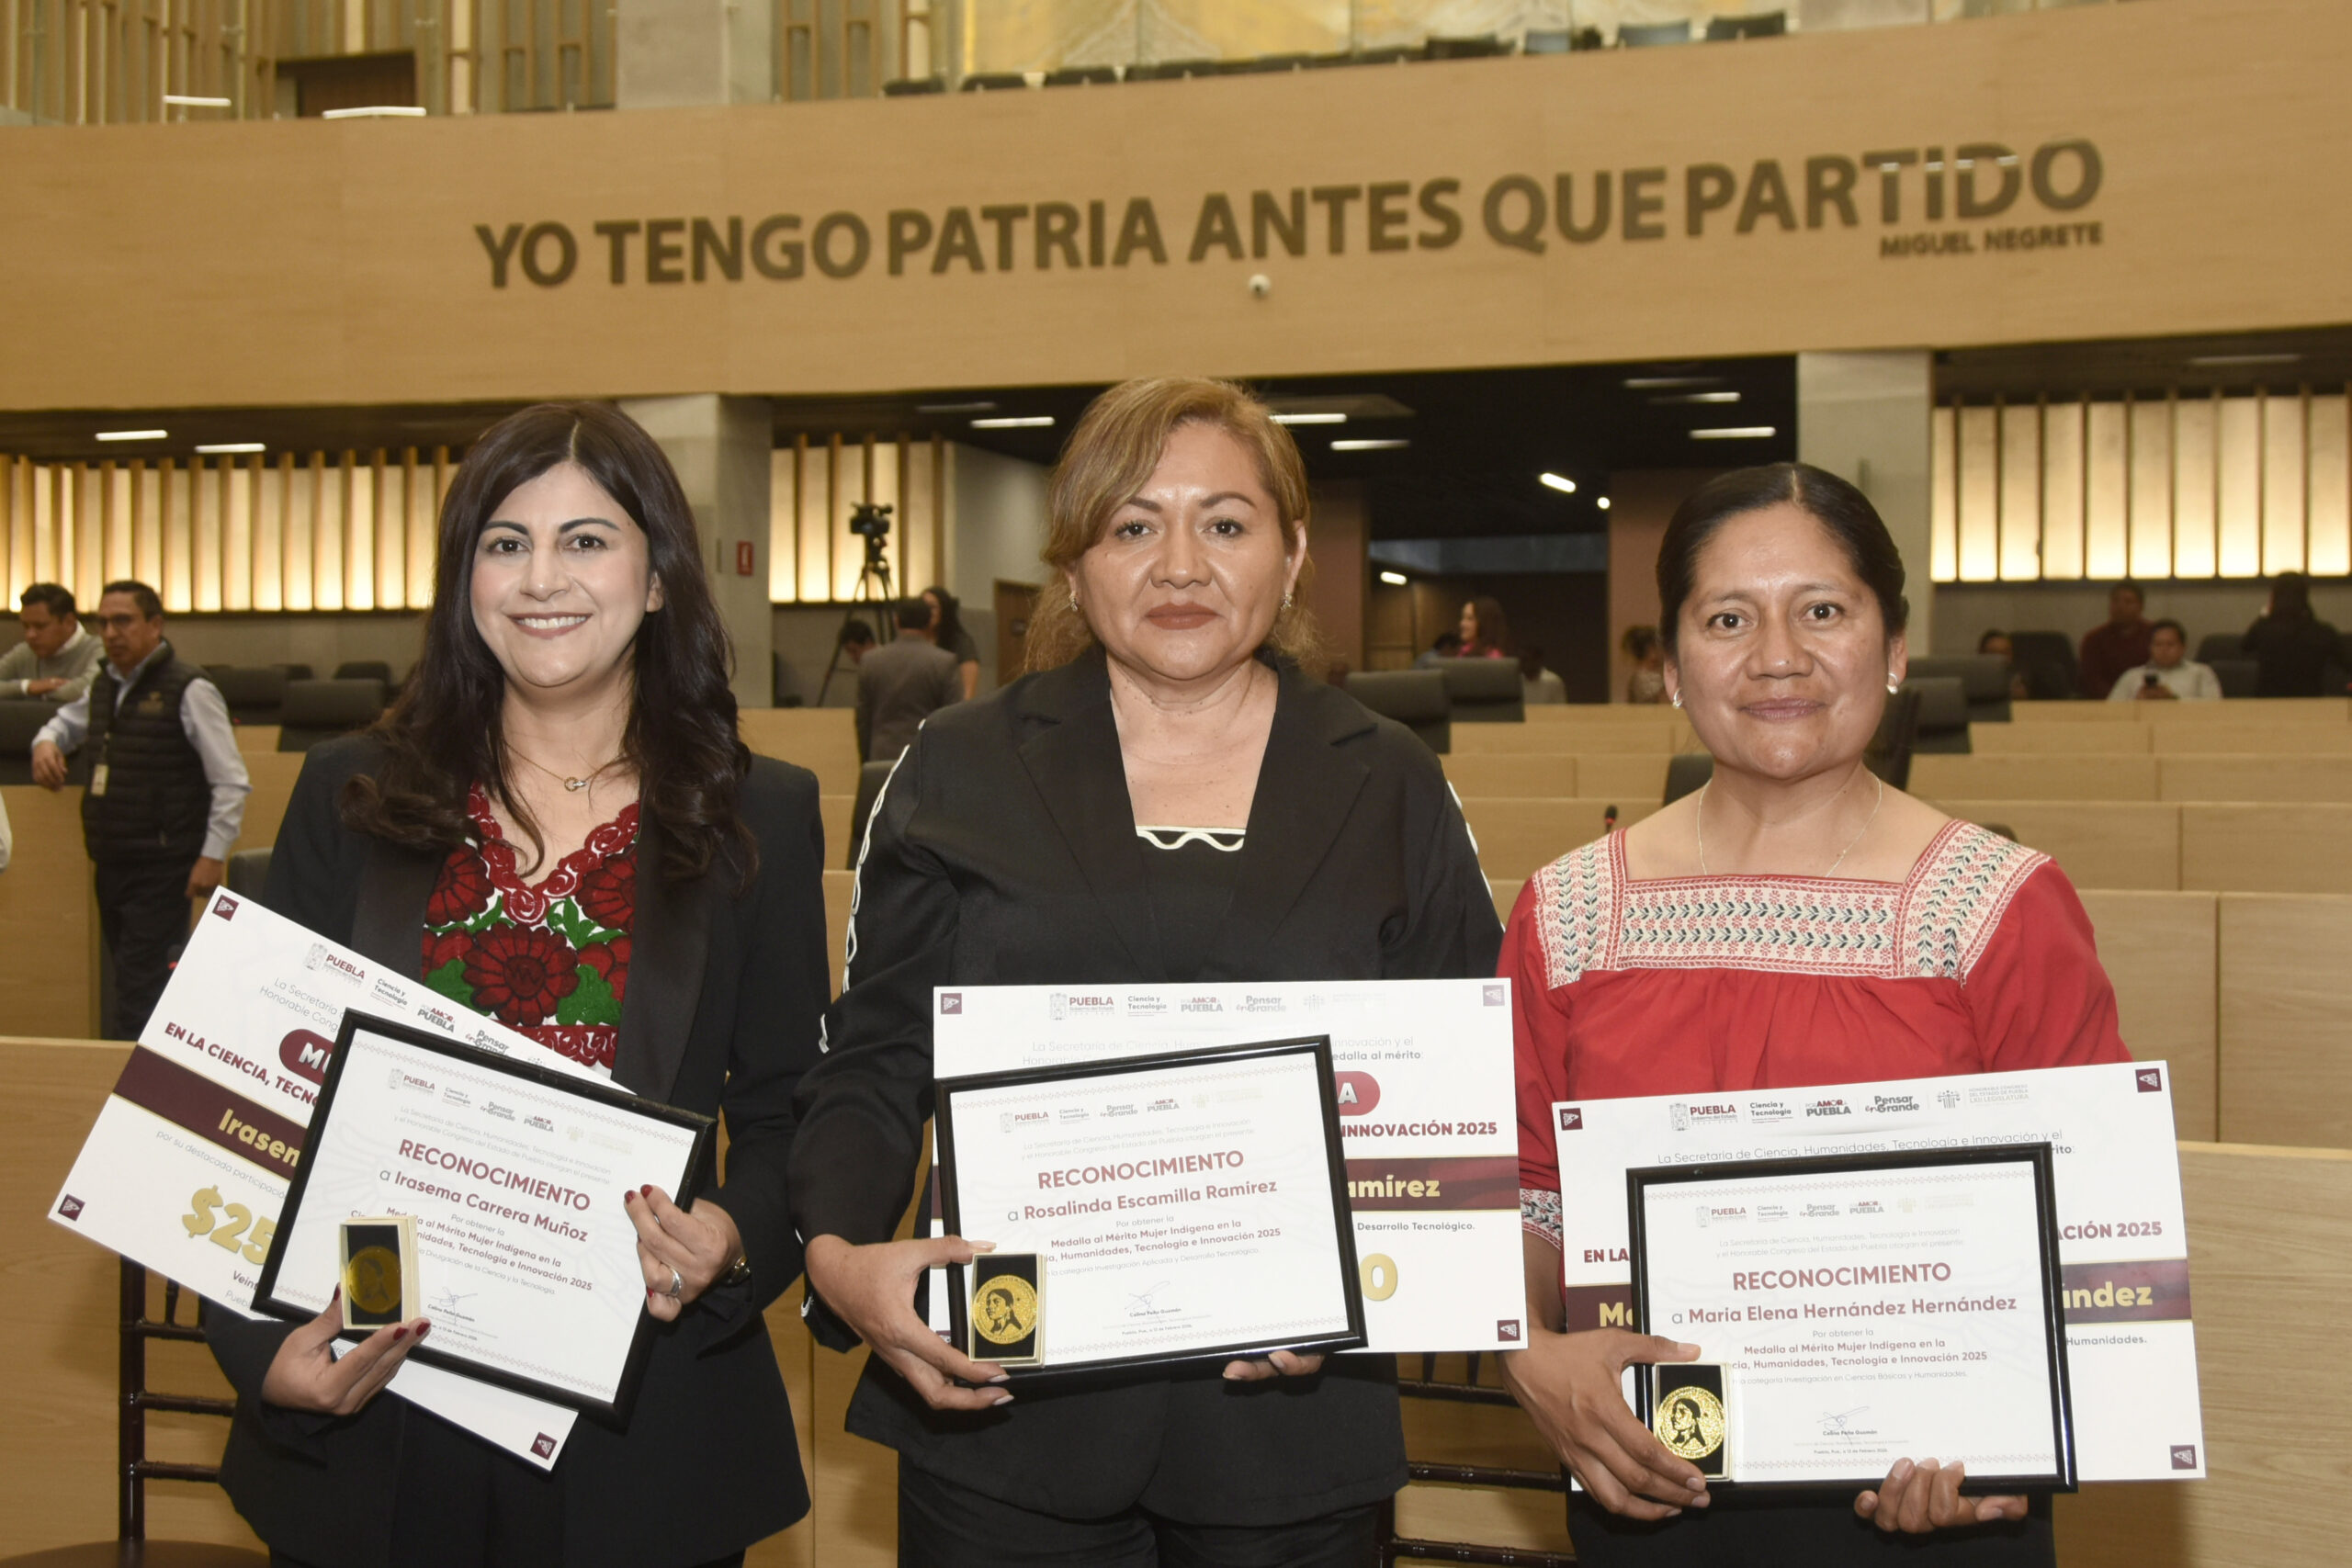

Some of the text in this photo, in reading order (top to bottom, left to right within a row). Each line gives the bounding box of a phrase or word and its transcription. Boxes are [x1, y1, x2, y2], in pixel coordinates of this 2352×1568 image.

[475, 140, 2103, 288] YO TENGO PATRIA ANTES QUE PARTIDO
[1880, 222, 2102, 258] MIGUEL NEGRETE
[311, 1011, 339, 1033] Cong
[1332, 1050, 1368, 1063] edalla
[1711, 1206, 1747, 1216] PUEBLA
[1733, 1261, 1951, 1292] RECONOCIMIENTO
[1671, 1313, 1683, 1325] a
[1747, 1304, 1798, 1322] Elena
[1804, 1300, 1906, 1319] Hernández
[1911, 1294, 2018, 1314] Hernández
[1812, 1327, 1874, 1338] Por obtener la
[1744, 1344, 1786, 1355] Medalla
[1788, 1344, 1799, 1354] al
[1801, 1343, 1835, 1353] Mérito
[1837, 1341, 1867, 1353] Mujer
[1918, 1340, 1933, 1348] en
[1935, 1338, 1946, 1348] la
[1753, 1358, 1828, 1370] Humanidades,
[1900, 1352, 1960, 1364] Innovación
[1962, 1350, 1988, 1361] 2025
